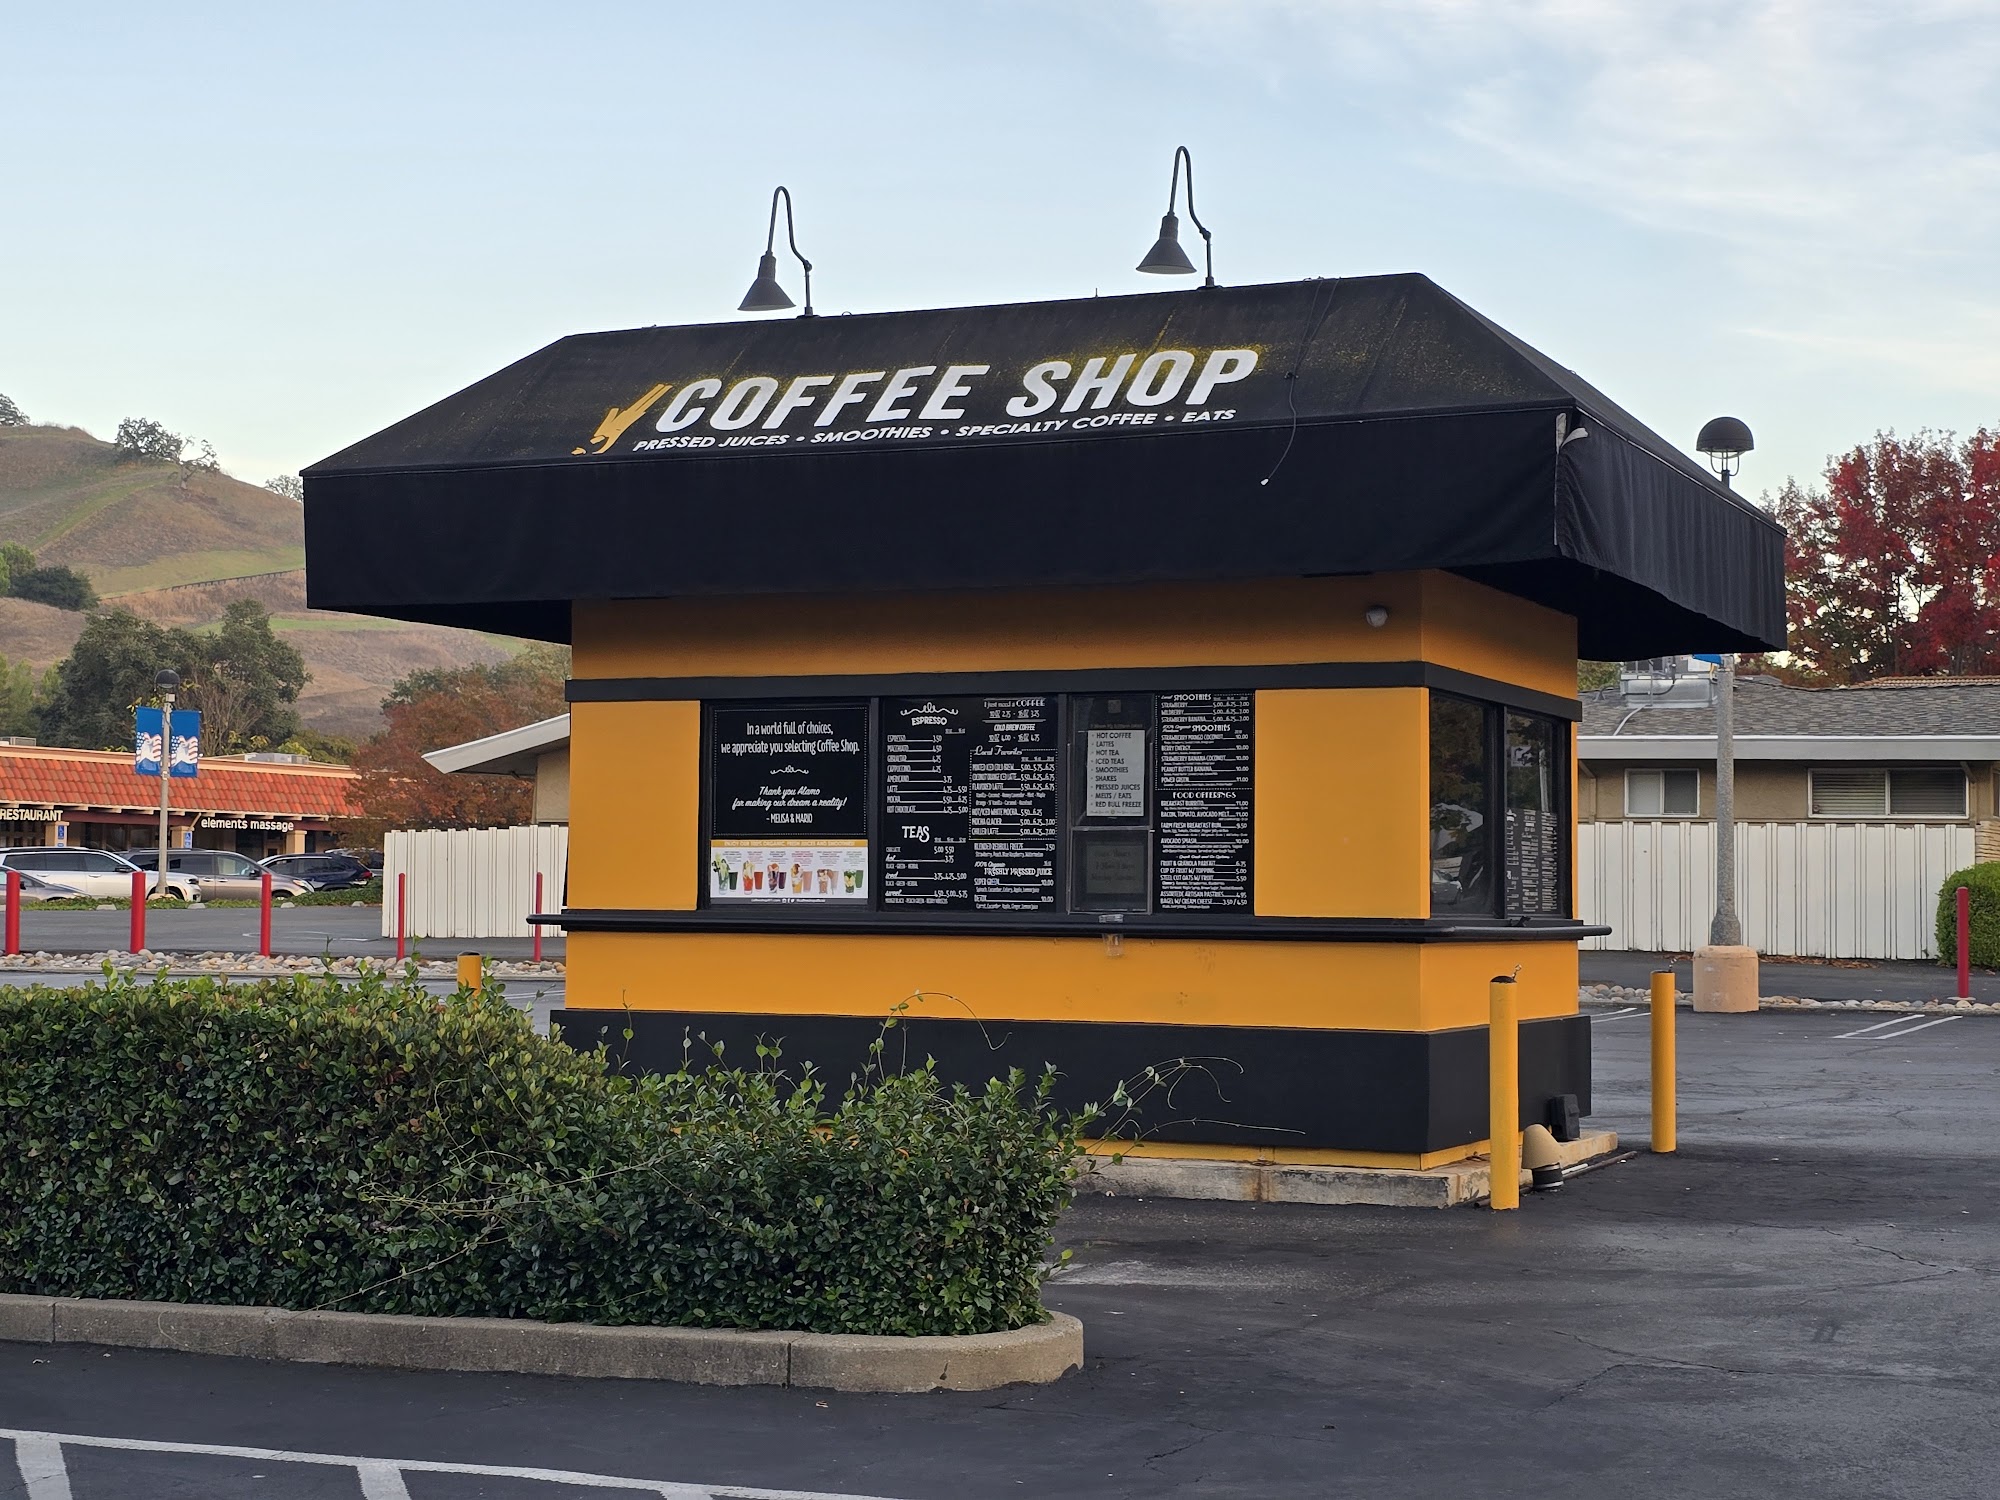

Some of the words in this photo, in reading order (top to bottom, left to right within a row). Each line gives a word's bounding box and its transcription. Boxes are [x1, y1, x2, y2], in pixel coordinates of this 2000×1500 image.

[655, 365, 991, 433] COFFEE
[1005, 350, 1259, 417] SHOP
[632, 436, 716, 452] PRESSED
[718, 435, 790, 447] JUICES
[810, 426, 933, 444] SMOOTHIES
[955, 420, 1069, 437] SPECIALTY
[1072, 413, 1158, 430] COFFEE
[1181, 409, 1237, 423] EATS
[1016, 699, 1045, 707] COFFEE
[911, 716, 948, 726] ESPRESSO
[746, 722, 754, 735] In
[755, 724, 760, 735] a
[761, 722, 781, 735] world
[783, 721, 797, 735] full
[798, 721, 806, 735] of
[807, 721, 834, 736] choices,
[1019, 723, 1036, 731] COFFEE
[1192, 724, 1231, 732] SMOOTHIES
[933, 735, 943, 743] 3.50
[1096, 740, 1115, 748] LATTES
[721, 743, 731, 754] we
[732, 740, 768, 756] appreciate
[769, 742, 783, 756] you
[784, 740, 816, 756] selecting
[817, 739, 840, 752] Coffee
[840, 739, 860, 755] Shop.
[974, 745, 993, 755] Local
[994, 745, 1022, 755] Favorites
[760, 786, 782, 795] Thank
[781, 789, 796, 800] you
[797, 786, 820, 796] Alamo
[887, 785, 899, 793] LATTE
[1173, 791, 1195, 799] FOOD
[1195, 791, 1237, 799] OFFERINGS
[732, 797, 744, 811] for
[745, 797, 773, 811] making
[773, 799, 786, 807] our
[786, 797, 811, 807] dream
[818, 797, 847, 811] reality!
[0, 808, 63, 822] RESTAURANT
[790, 814, 795, 823] &
[795, 813, 813, 824] MARIO
[201, 818, 248, 830] elements
[250, 820, 294, 833] massage
[1020, 818, 1030, 826] 5.00
[902, 825, 930, 843] TEAS
[1020, 828, 1030, 836] 5.00
[934, 846, 944, 854] 5.00
[945, 846, 955, 854] 5.50
[984, 868, 1009, 877] FRESHLY
[1010, 868, 1036, 877] PRESSED
[1036, 868, 1053, 877] JUICE
